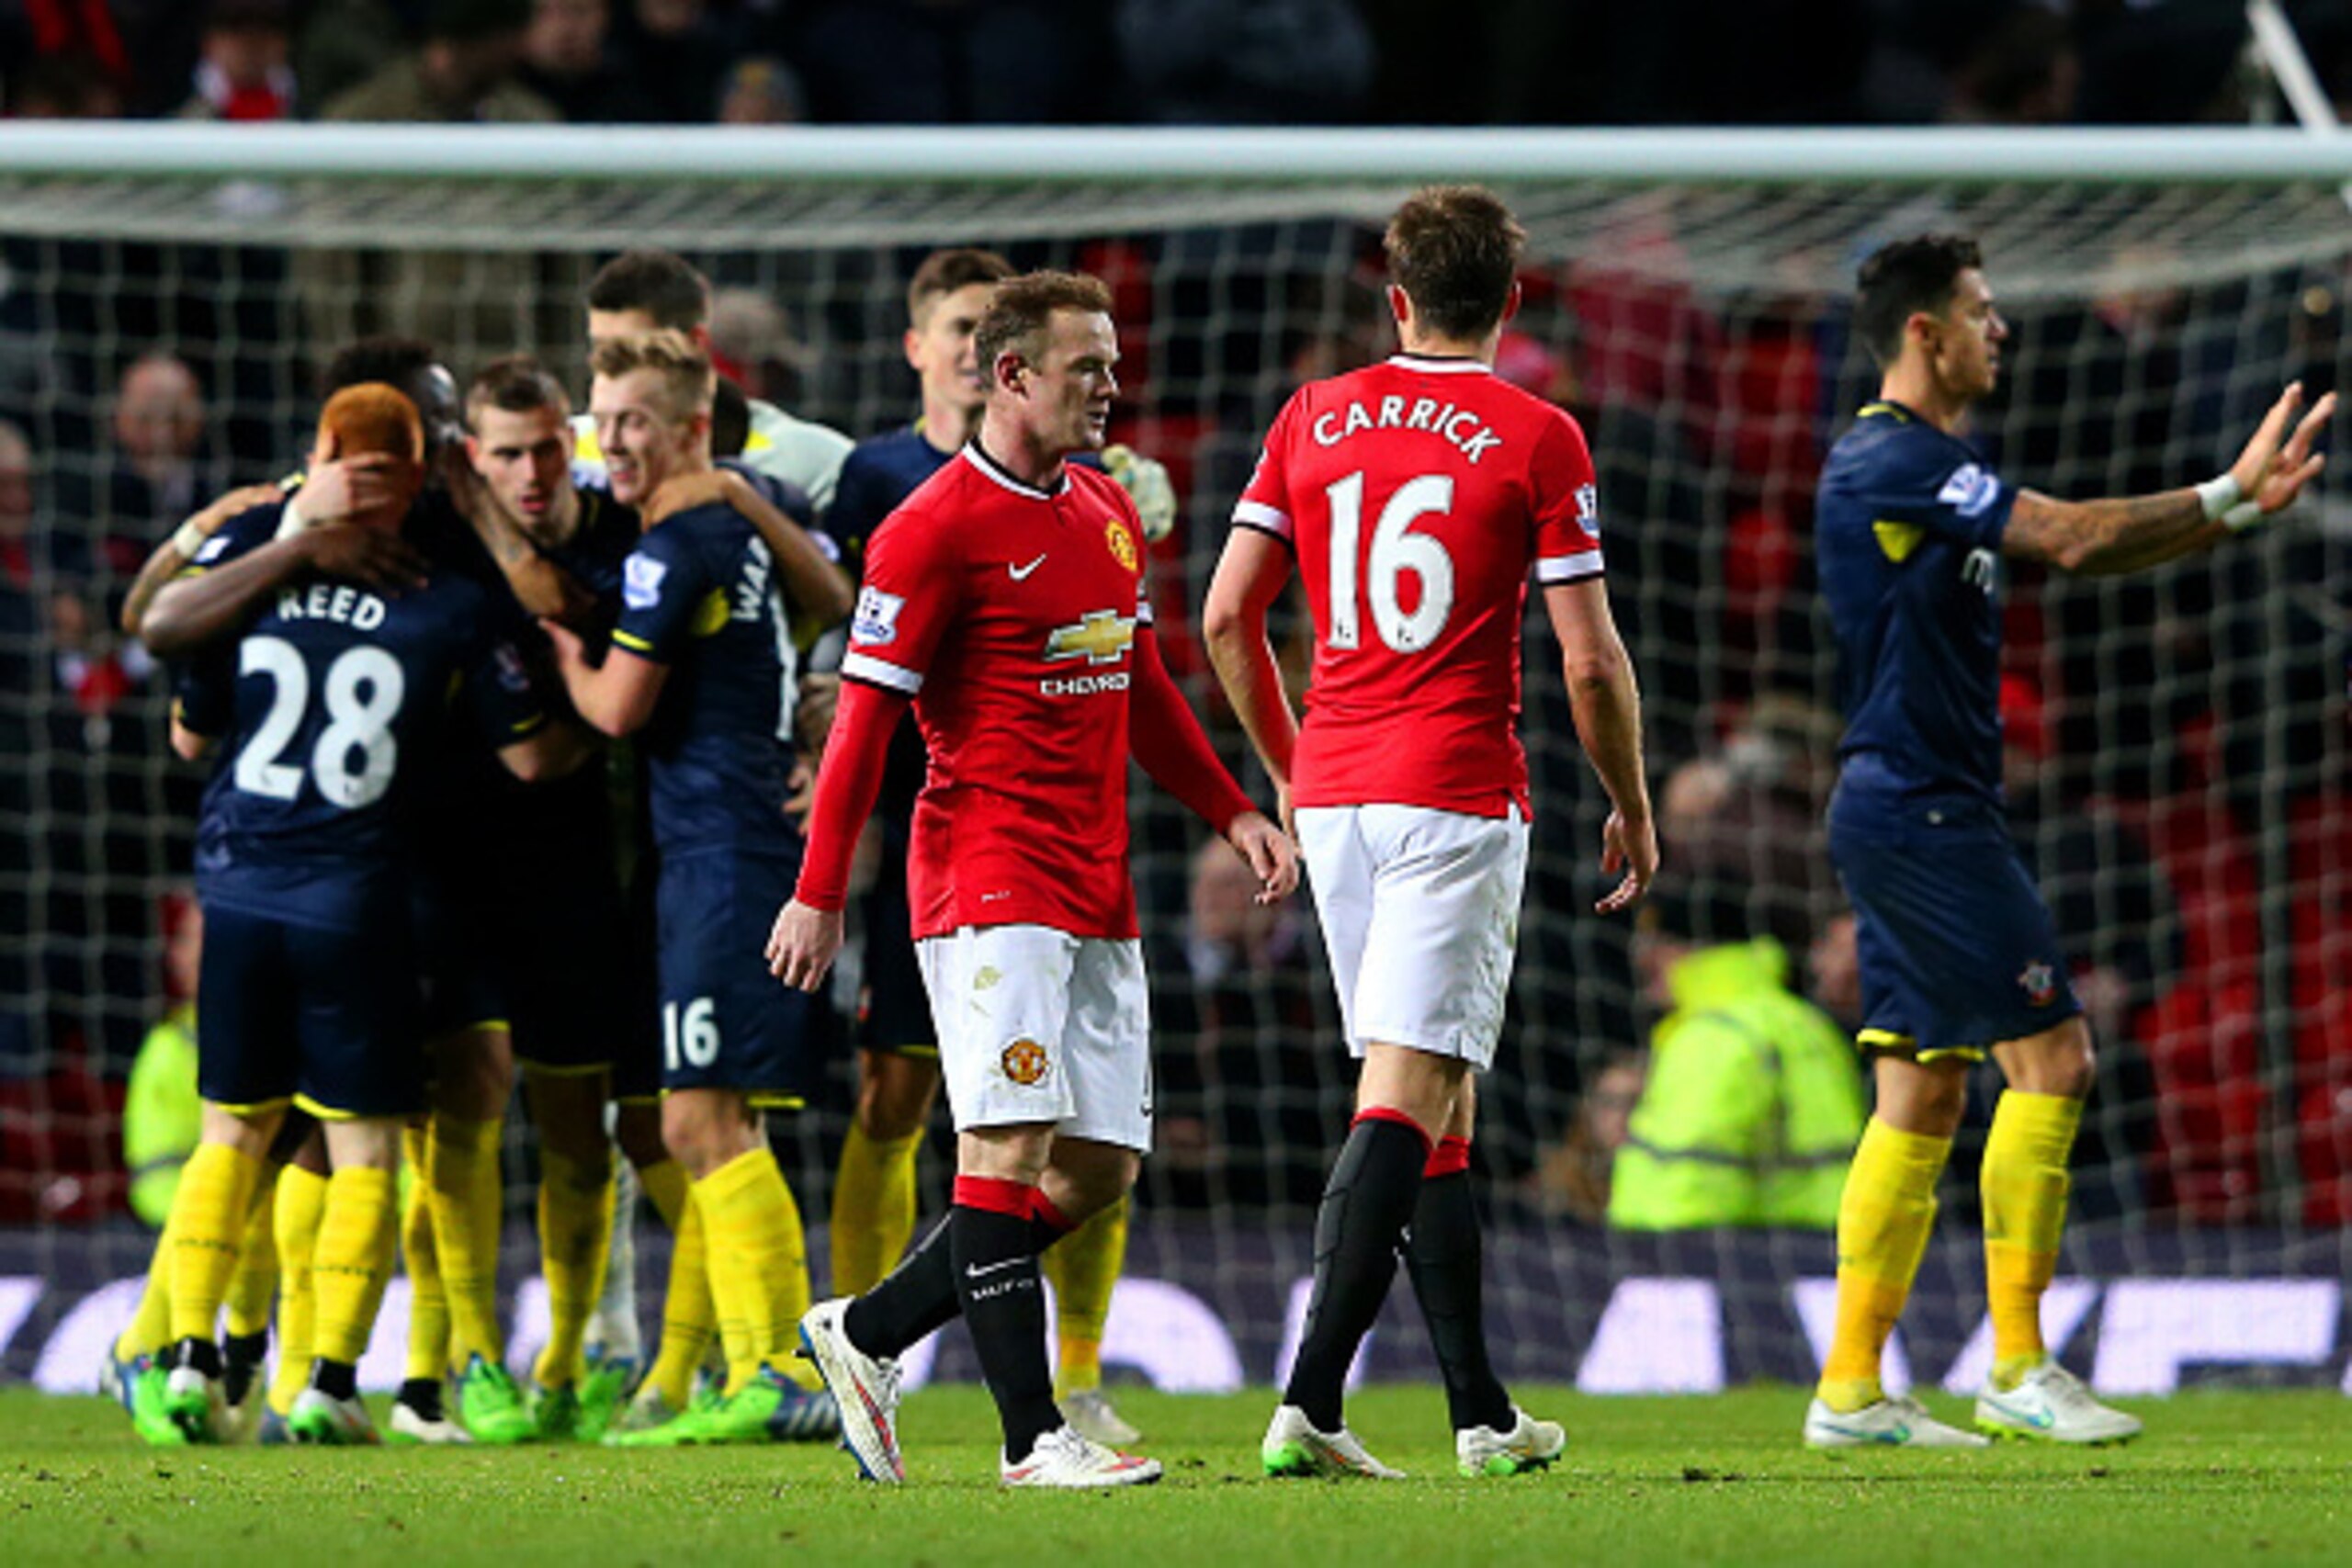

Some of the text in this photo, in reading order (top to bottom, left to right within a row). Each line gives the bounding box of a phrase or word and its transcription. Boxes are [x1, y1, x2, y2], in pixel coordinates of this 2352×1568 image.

[1313, 395, 1503, 464] CARRICK
[1326, 469, 1454, 655] 16
[235, 635, 404, 809] 28
[663, 996, 720, 1071] 16
